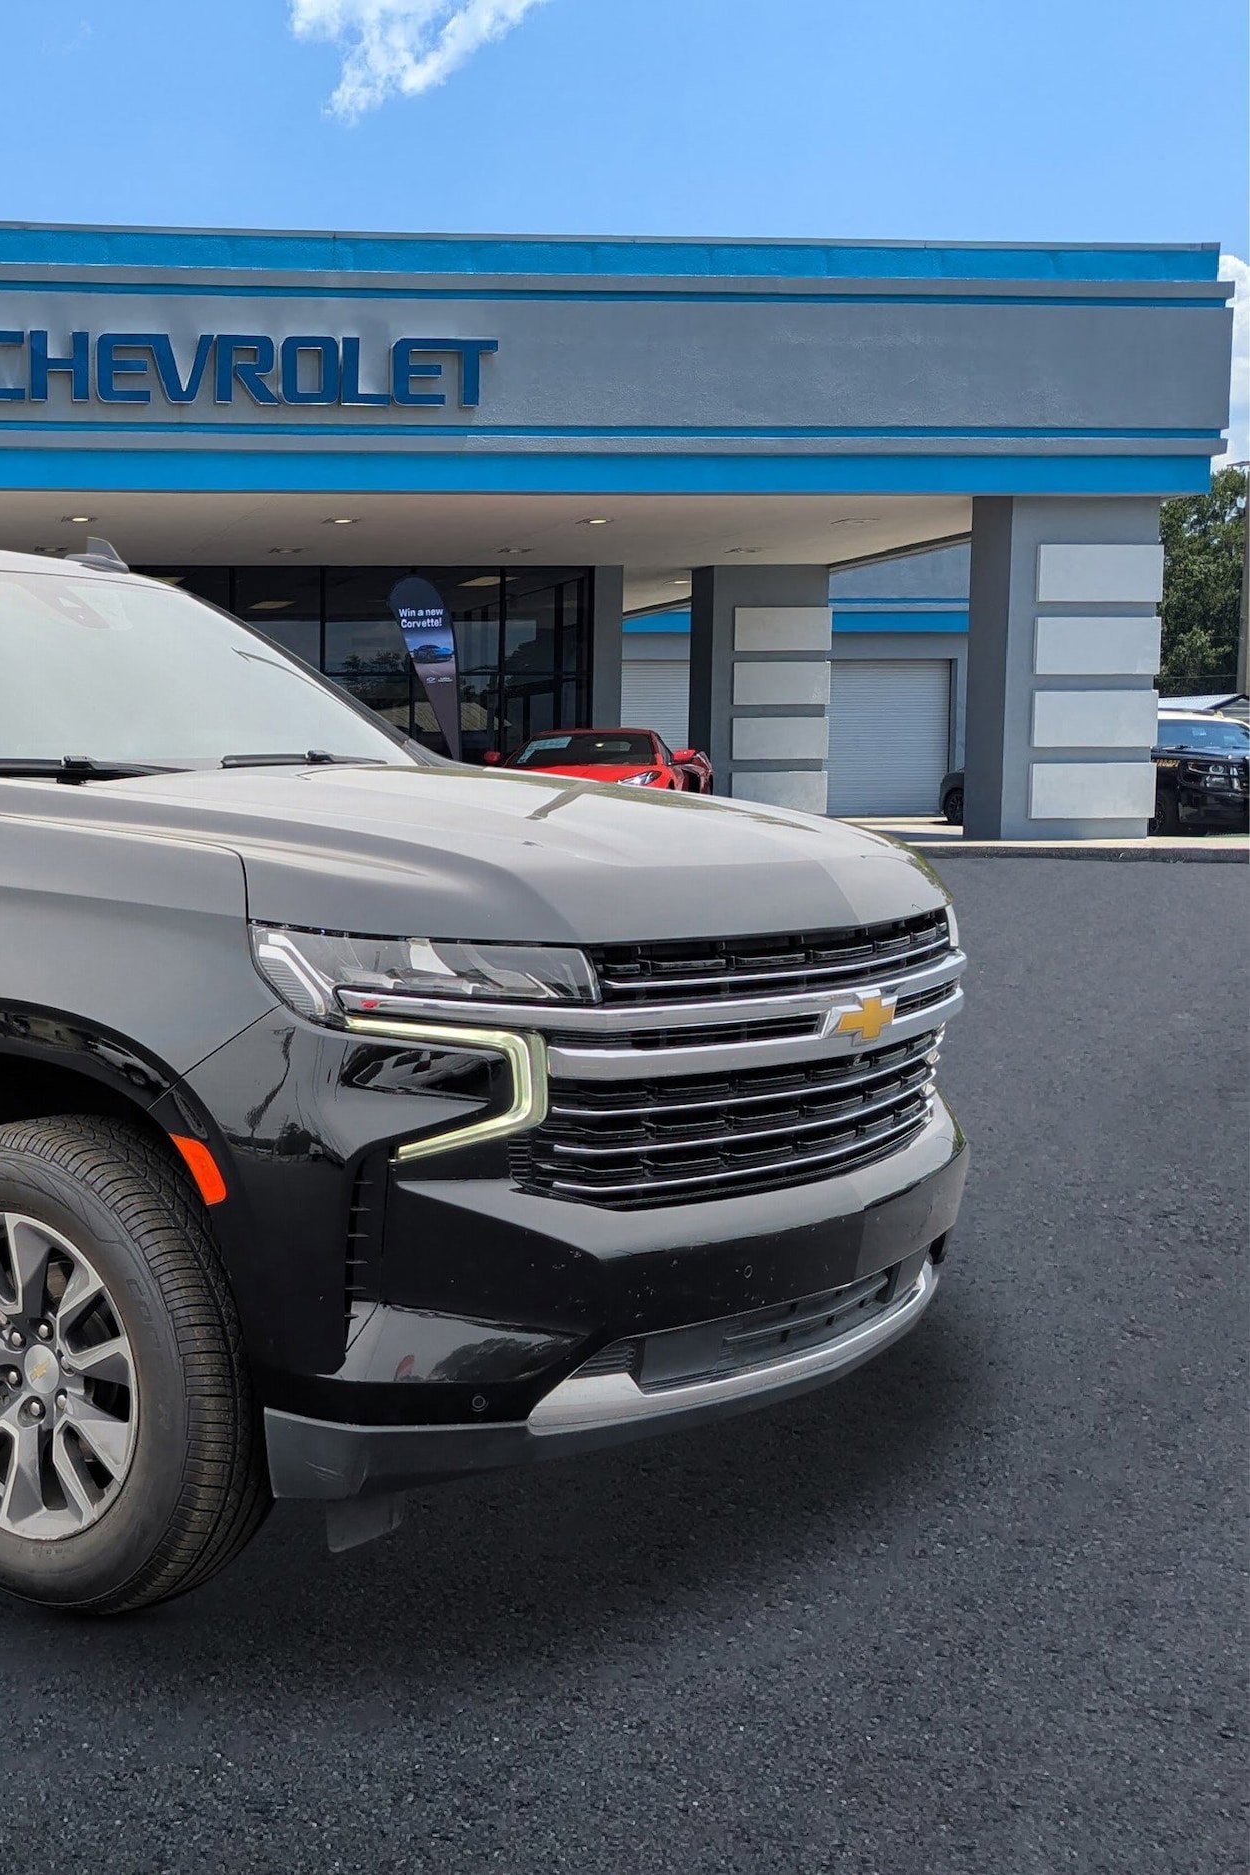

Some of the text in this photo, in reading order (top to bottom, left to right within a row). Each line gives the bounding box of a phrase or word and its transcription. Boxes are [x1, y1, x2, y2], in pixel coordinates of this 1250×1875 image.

[398, 608, 416, 617] Win
[417, 609, 424, 617] a
[400, 617, 442, 628] Corvette!
